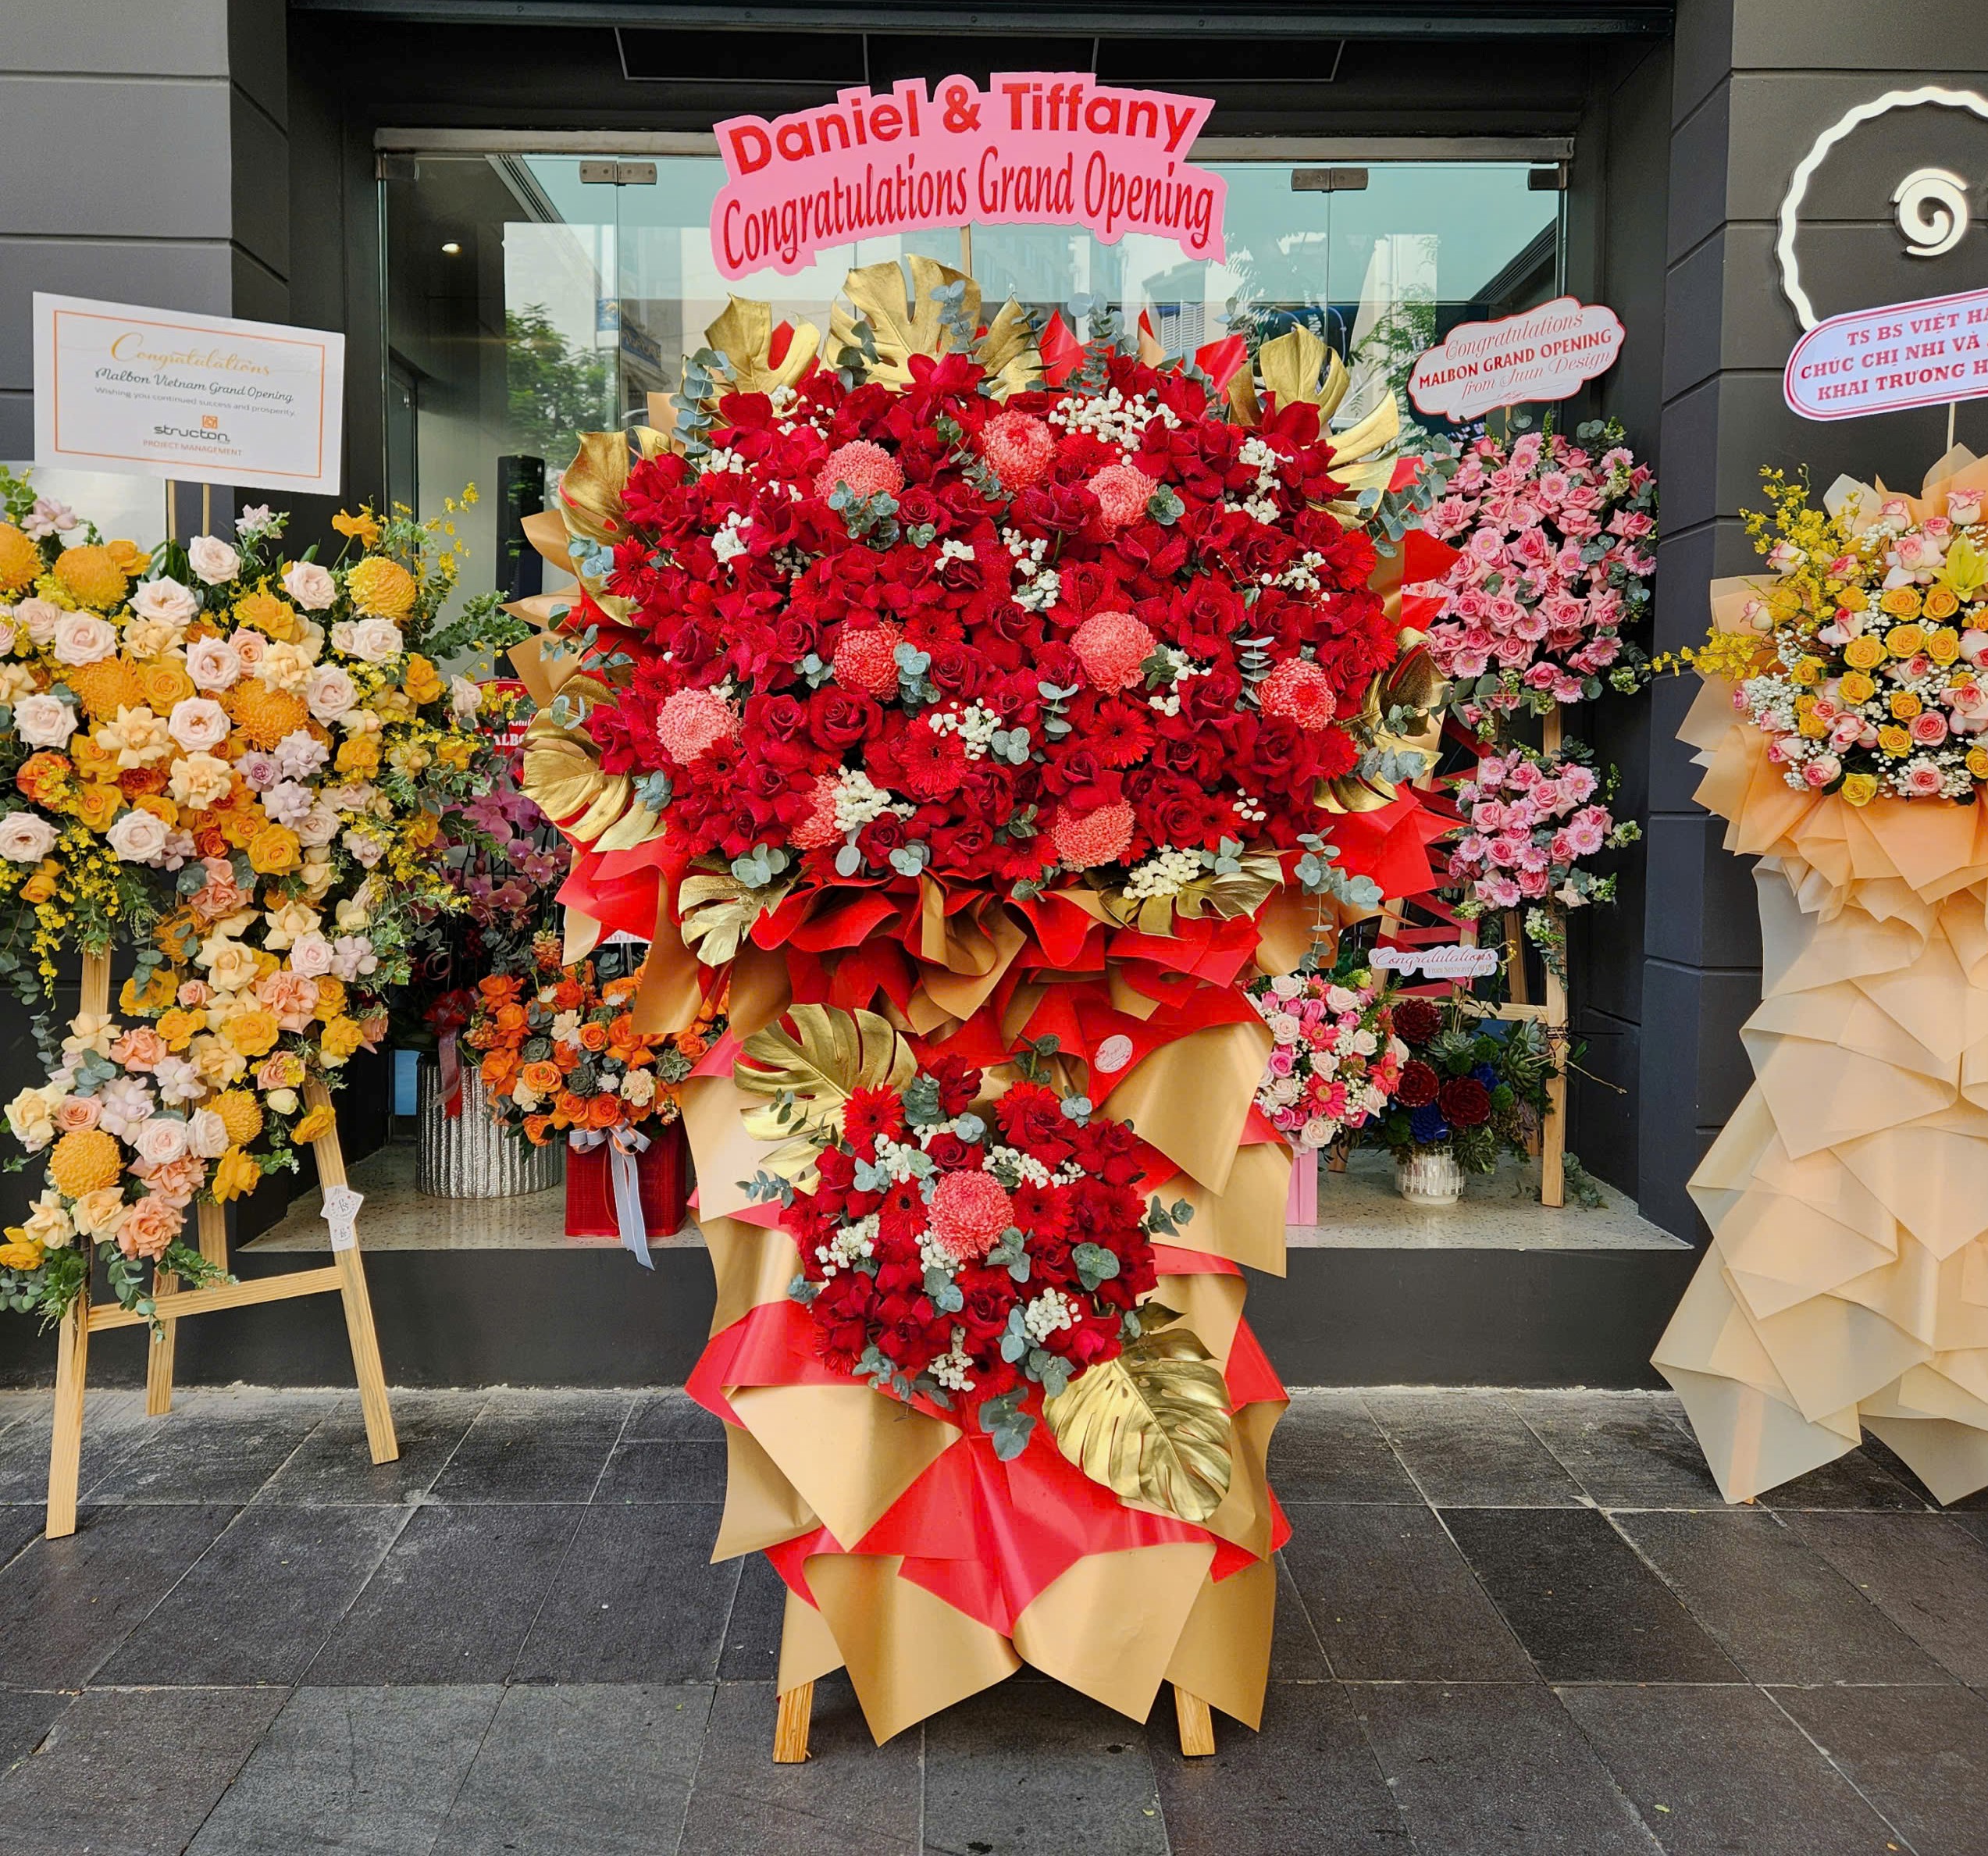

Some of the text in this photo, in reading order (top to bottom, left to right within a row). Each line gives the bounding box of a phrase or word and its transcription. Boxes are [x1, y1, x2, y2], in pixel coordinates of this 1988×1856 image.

[728, 82, 1197, 176] Daniel & Tiffany
[723, 145, 1214, 270] Congratulations Grand Opening
[1445, 312, 1584, 361] Congratulations
[1847, 330, 1870, 347] TS
[1877, 323, 1903, 341] BS
[1910, 312, 1960, 335] VIỆT
[111, 332, 270, 376] Congratulations
[1419, 329, 1612, 390] MALBON GRAND OPENING
[1462, 379, 1495, 401] from
[1548, 351, 1612, 376] Design
[1801, 331, 1980, 379] CHÚC CHỊ NHI VÀ
[94, 367, 294, 404] Malbon Vietnam Grand Opening
[94, 386, 132, 400] Wishing
[134, 391, 151, 401] you
[152, 394, 197, 405] continued
[199, 398, 232, 409] success
[1817, 379, 1869, 401] KHAI
[1876, 362, 1965, 391] TRƯƠNG
[143, 439, 243, 456] PROJECT MANAGEMENT
[1373, 947, 1493, 971] Congratulations
